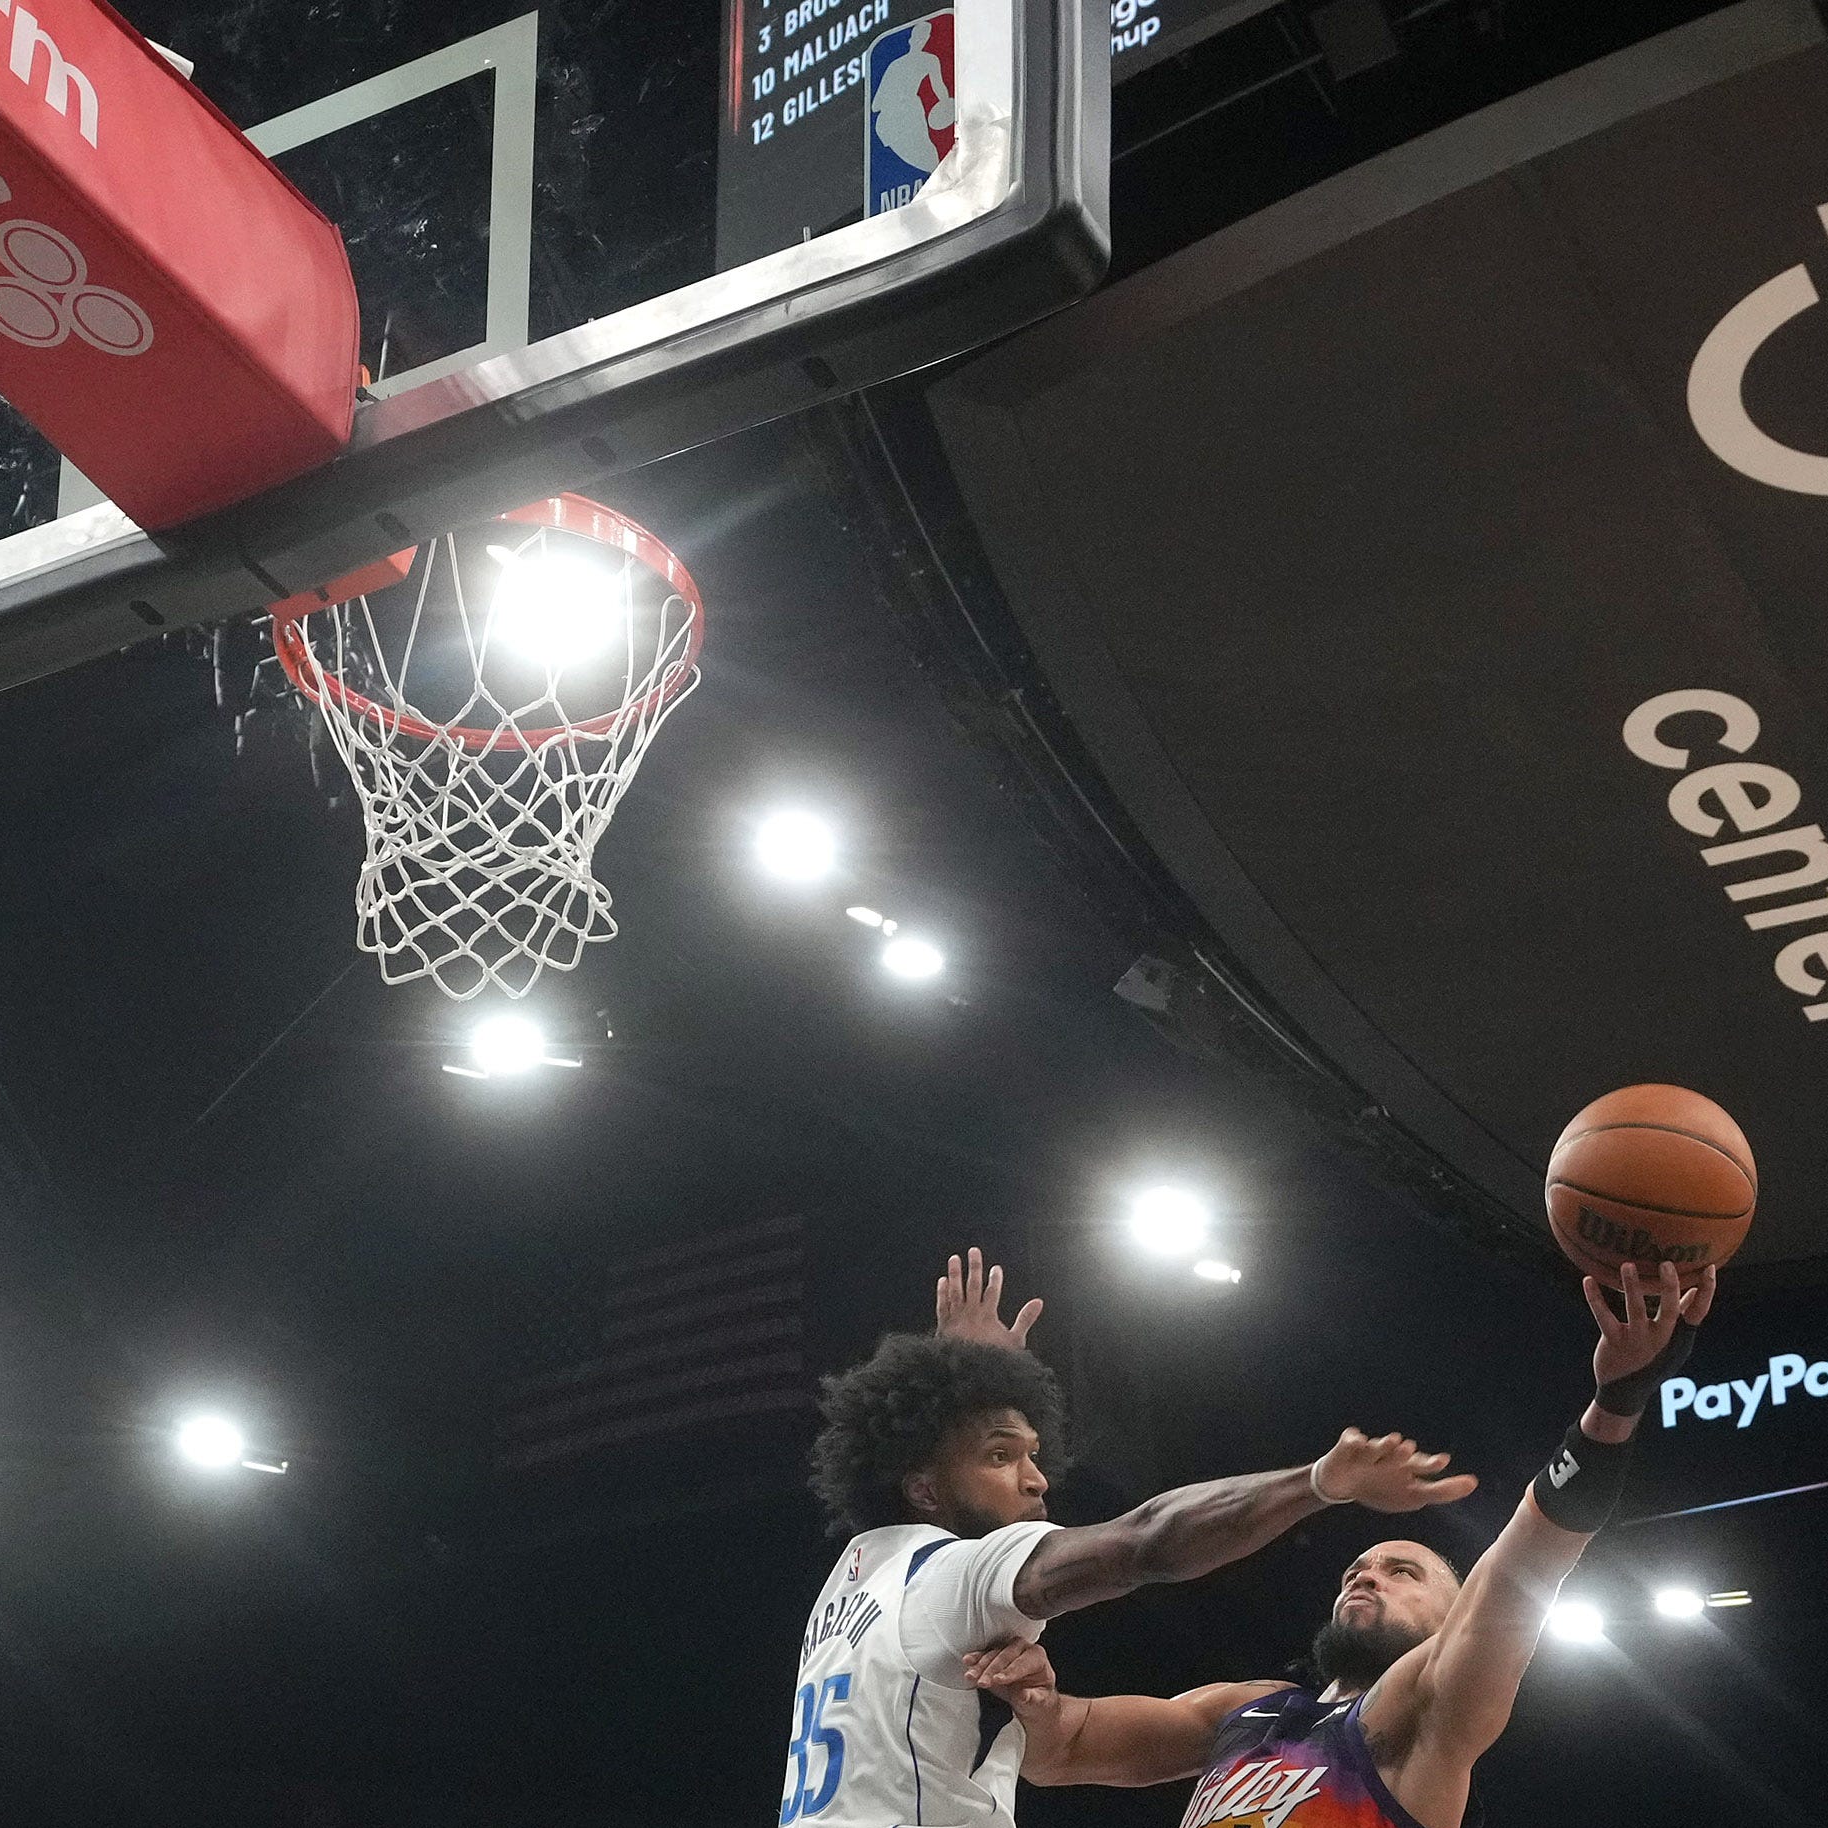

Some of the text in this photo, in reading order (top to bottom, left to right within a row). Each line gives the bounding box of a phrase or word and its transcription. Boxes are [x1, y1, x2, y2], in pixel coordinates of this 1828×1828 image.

[752, 0, 889, 101] 10 MALUACH
[758, 25, 771, 53] 3
[751, 112, 775, 145] 12
[779, 1673, 852, 1828] 35
